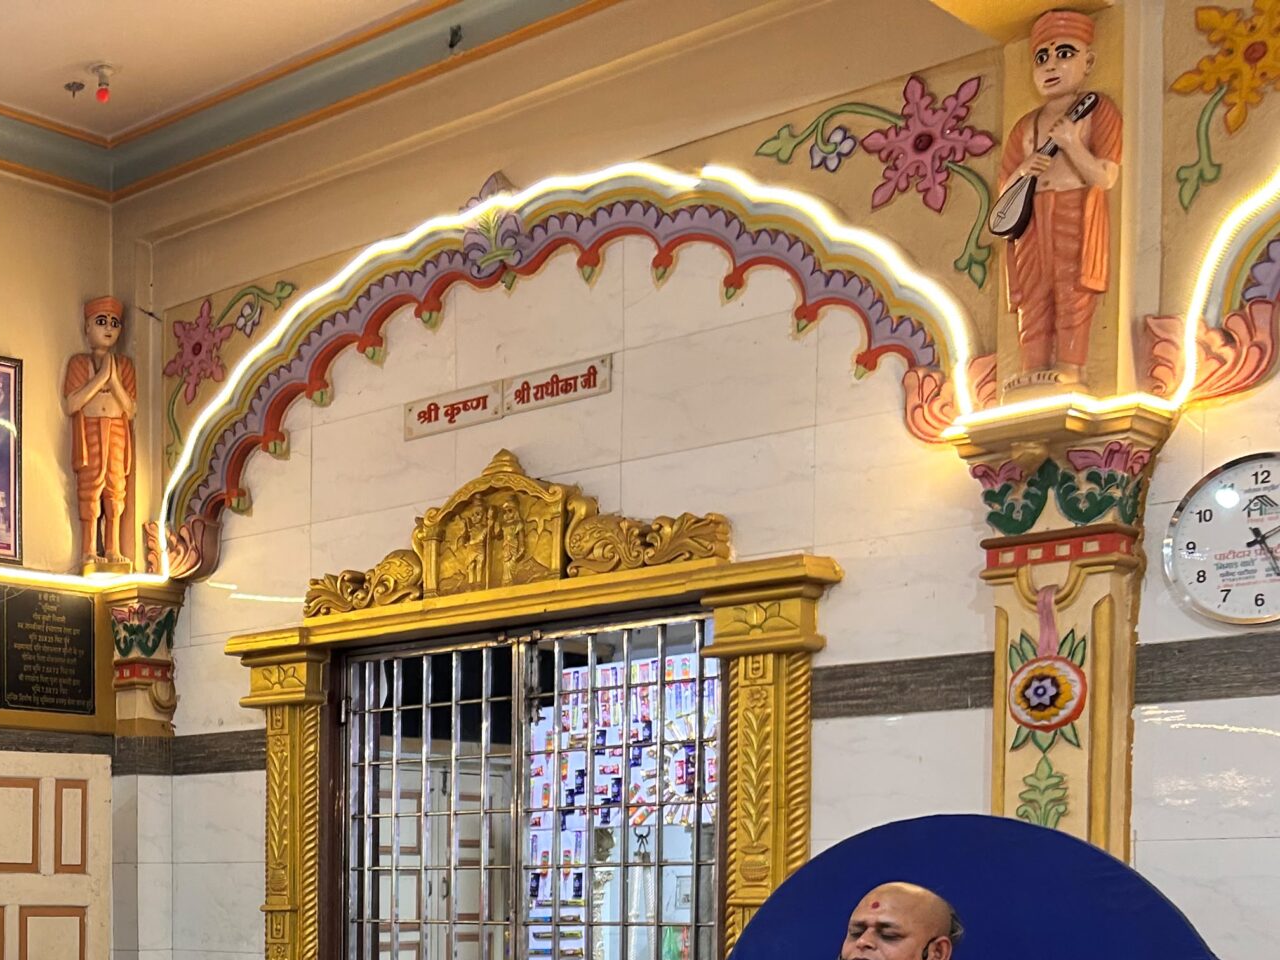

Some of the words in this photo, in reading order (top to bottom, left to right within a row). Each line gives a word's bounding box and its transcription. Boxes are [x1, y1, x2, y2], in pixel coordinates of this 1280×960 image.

[514, 381, 531, 405] श्री
[533, 374, 578, 401] राधीका
[580, 365, 598, 389] जी
[417, 403, 440, 424] श्री
[443, 395, 489, 424] कृष्ण
[1251, 470, 1271, 485] 12
[1195, 509, 1213, 523] 10
[1186, 542, 1196, 555] 9
[1196, 570, 1206, 583] 8
[1220, 589, 1232, 603] 7
[1254, 593, 1265, 607] 6
